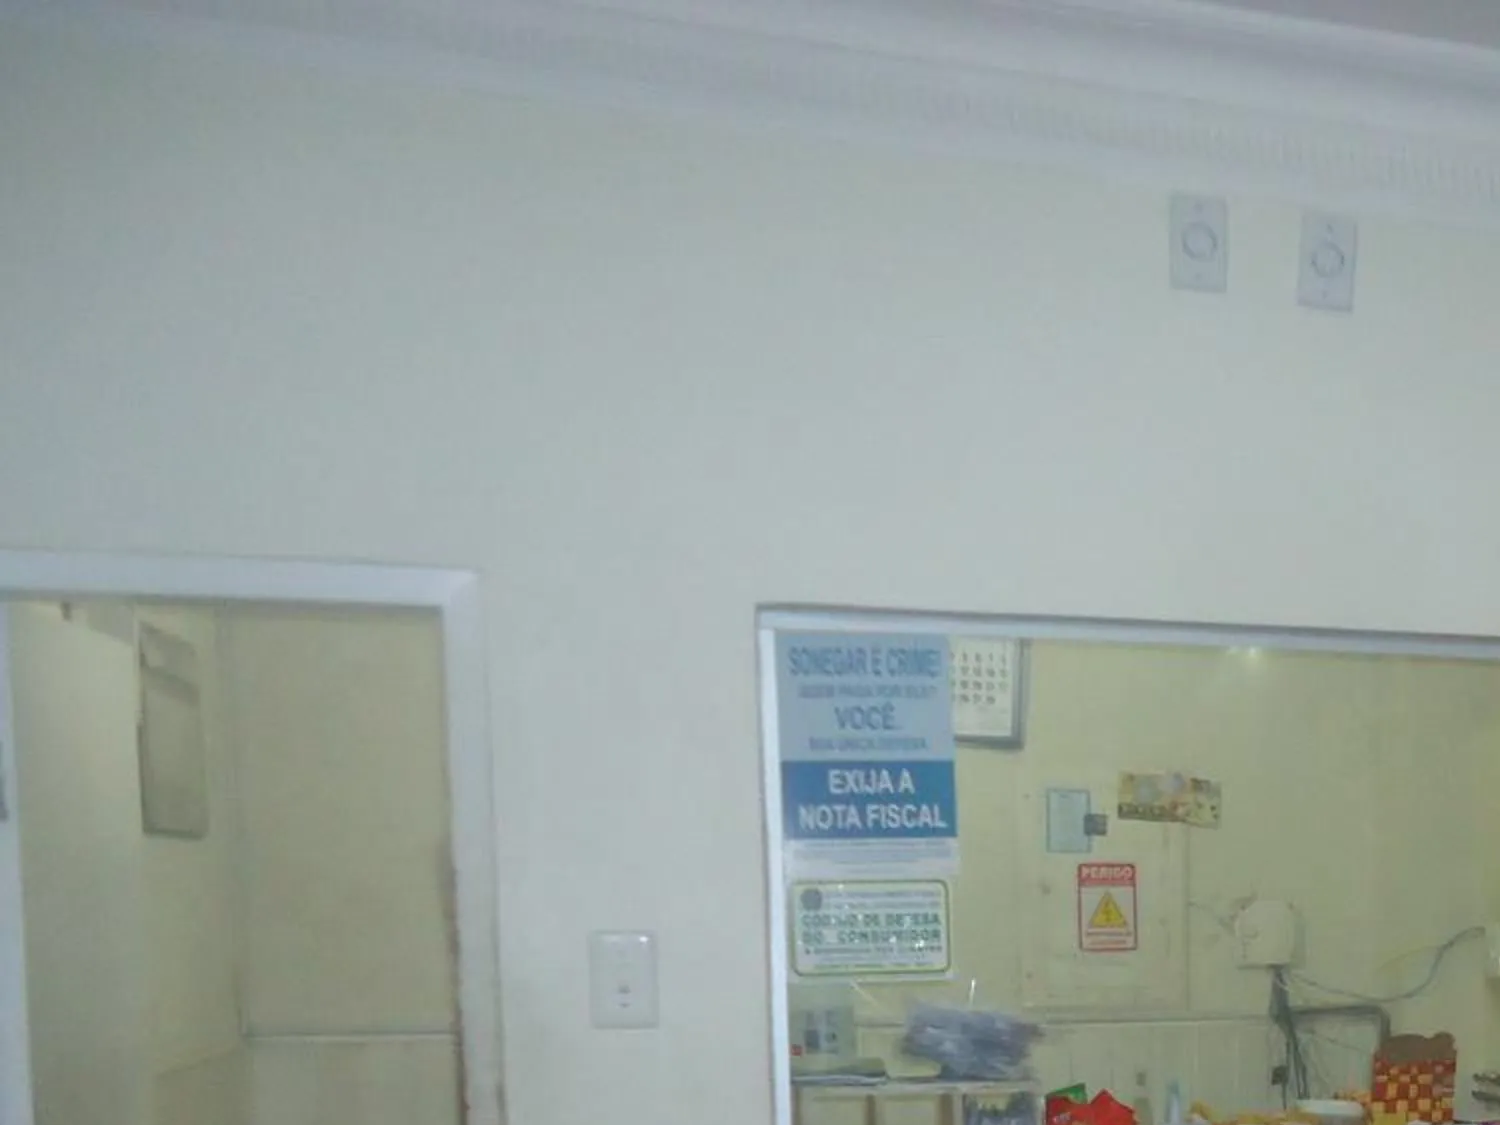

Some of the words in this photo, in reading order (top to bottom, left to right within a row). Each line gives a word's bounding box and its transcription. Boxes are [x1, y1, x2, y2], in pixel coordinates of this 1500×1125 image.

[828, 769, 894, 795] EXIJA
[899, 768, 915, 794] A
[800, 804, 862, 830] NOTA
[866, 804, 947, 829] FISCAL
